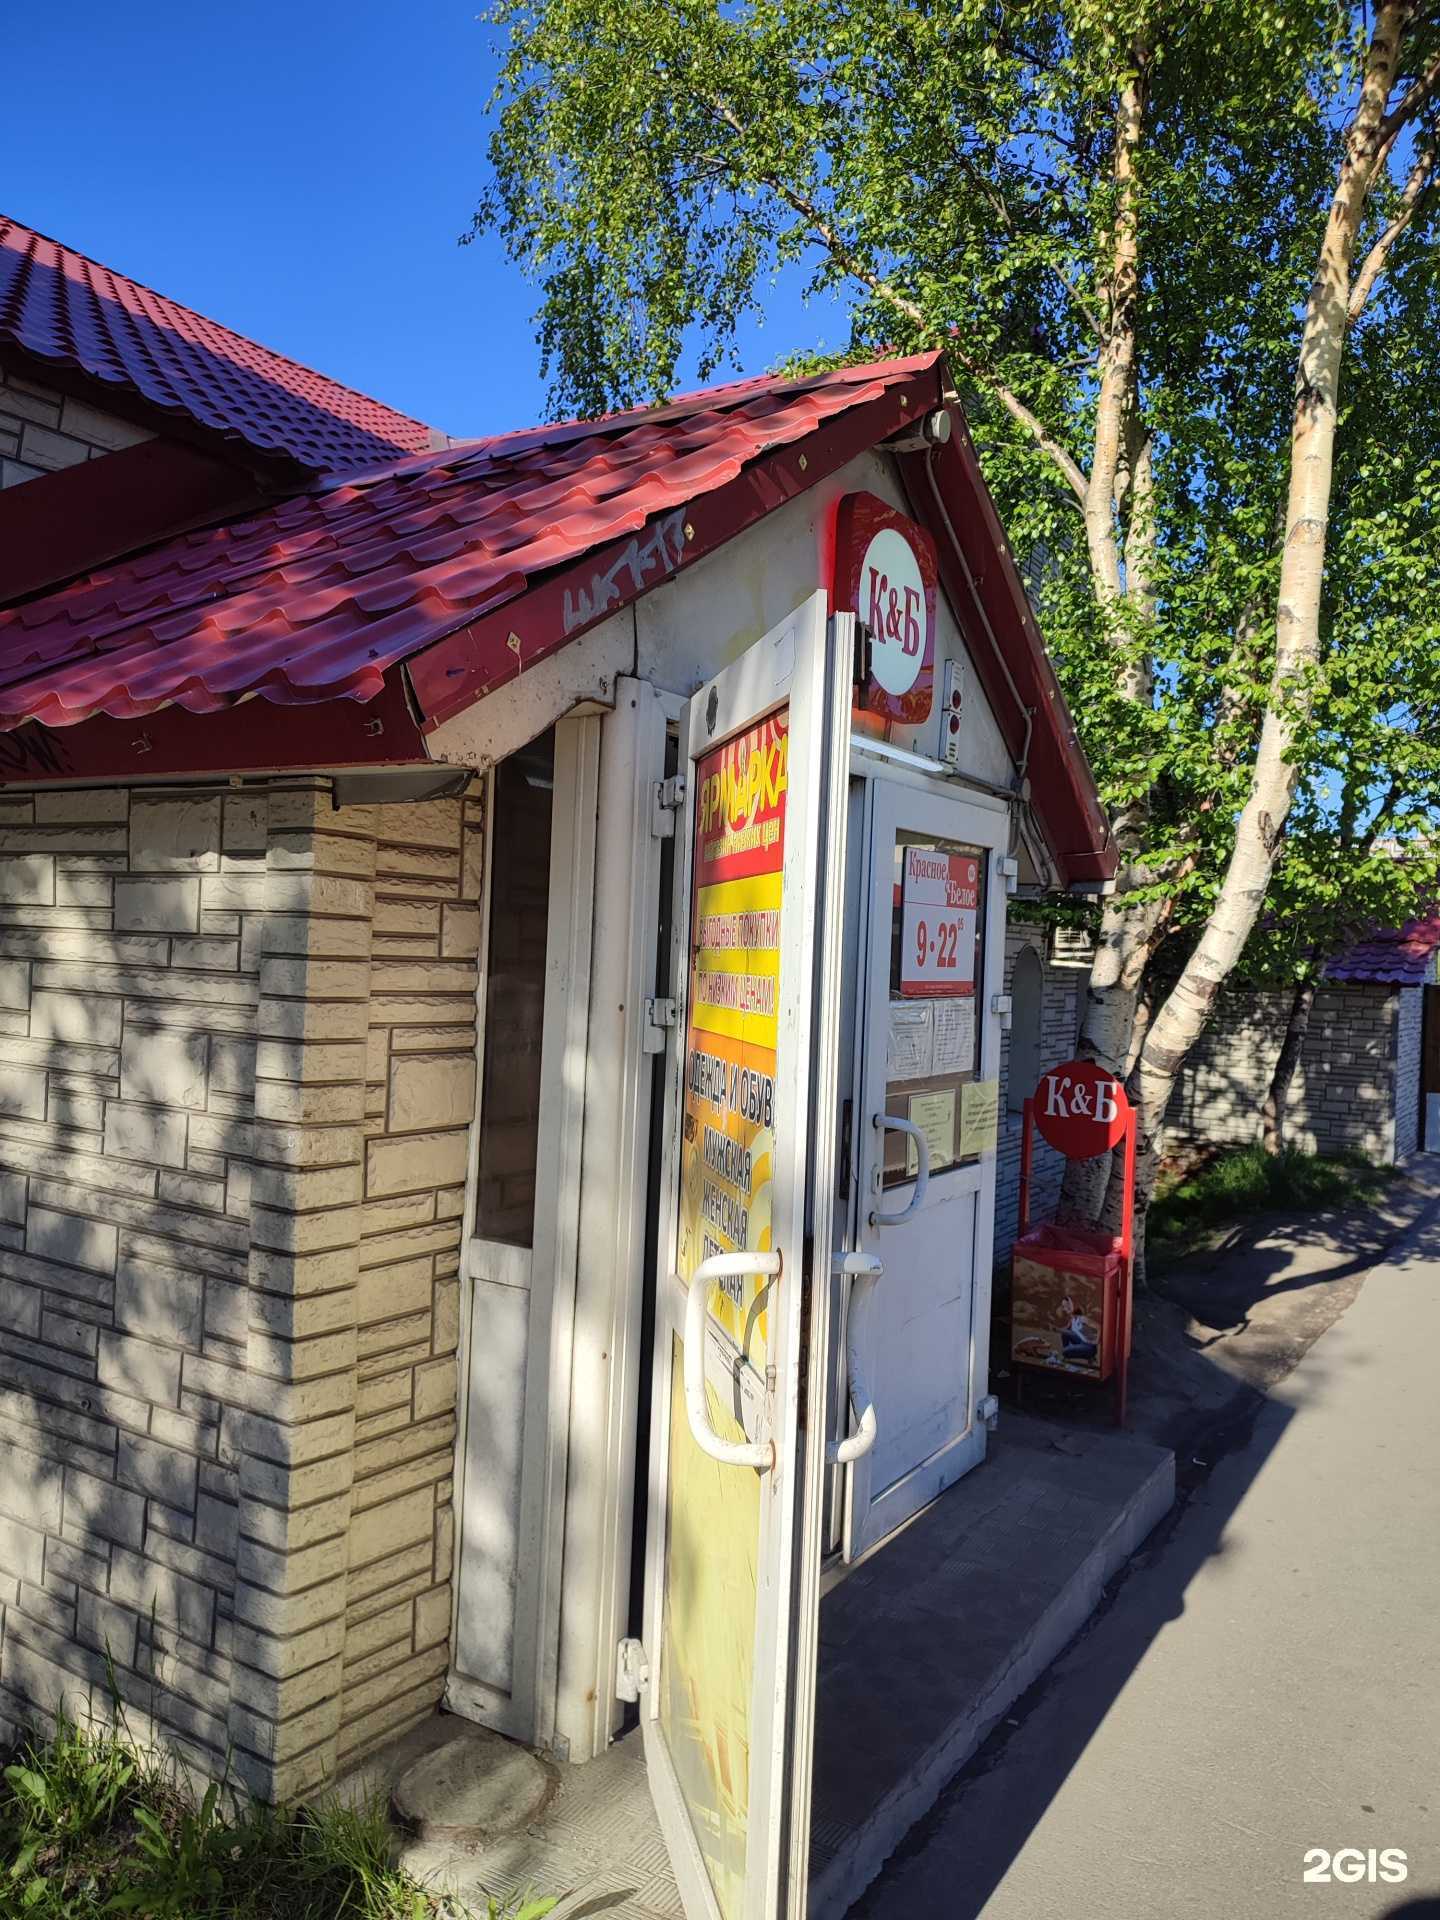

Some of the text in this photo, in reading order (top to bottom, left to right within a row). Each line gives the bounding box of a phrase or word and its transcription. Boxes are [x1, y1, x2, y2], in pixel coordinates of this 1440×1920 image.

[869, 566, 920, 657] К&Б
[909, 851, 947, 884] Красное
[951, 881, 975, 905] Белое
[689, 1051, 776, 1127] ОДЕЖДА И ОБУВ
[1044, 1075, 1118, 1123] К&Б
[704, 1126, 751, 1192] МУЖСКАЯ
[703, 1181, 747, 1249] ЖЕНСКАЯ
